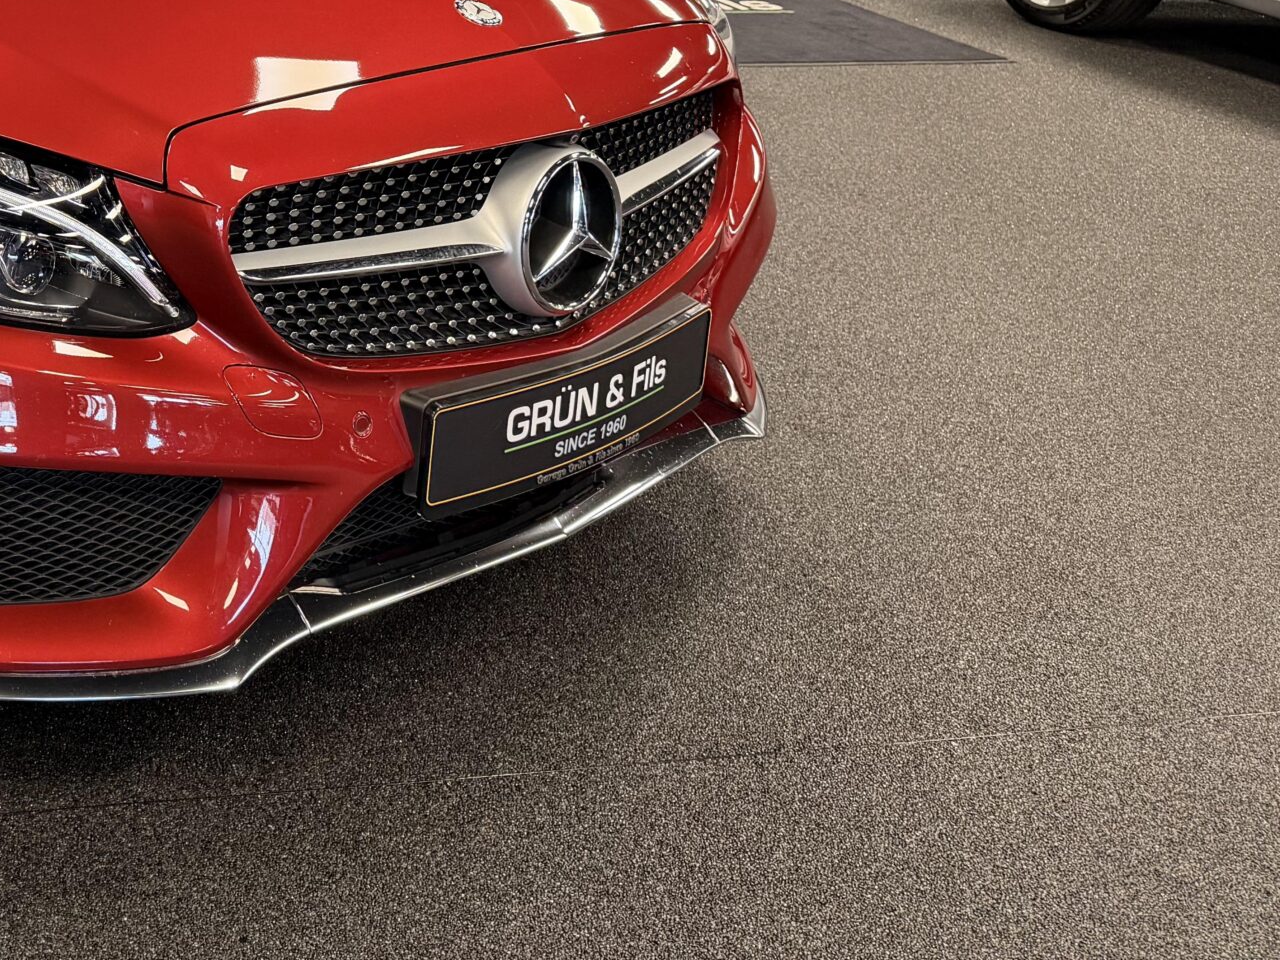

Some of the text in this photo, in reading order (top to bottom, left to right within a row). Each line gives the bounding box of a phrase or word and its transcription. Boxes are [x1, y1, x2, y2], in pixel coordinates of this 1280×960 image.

[506, 355, 667, 443] GRÜN & Fils
[554, 414, 627, 457] SINCE 1960
